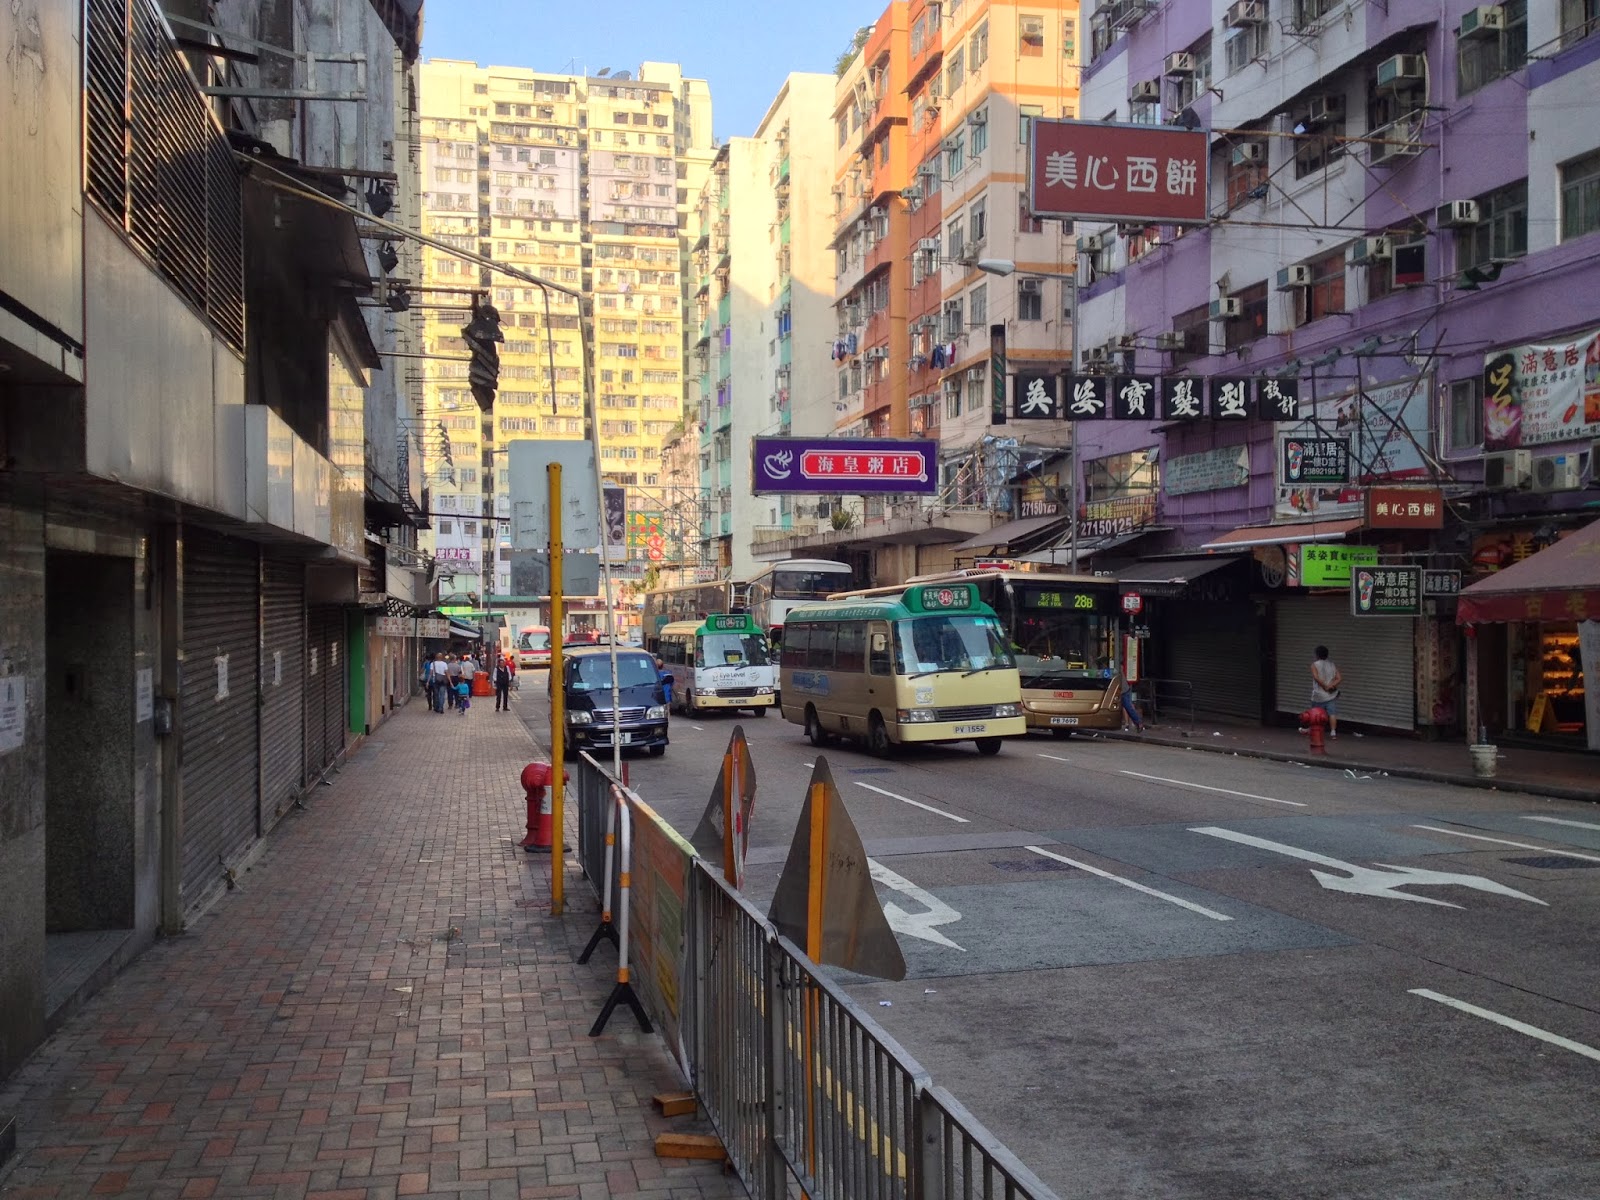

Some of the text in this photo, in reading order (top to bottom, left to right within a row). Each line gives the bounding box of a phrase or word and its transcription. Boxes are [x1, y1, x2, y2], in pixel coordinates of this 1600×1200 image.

[1045, 151, 1197, 196] 美心西餅
[1521, 343, 1580, 374] 滿意居
[1303, 442, 1337, 457] 滿意居
[818, 455, 909, 474] 海皇粥店
[1303, 467, 1337, 475] 23892196
[1376, 503, 1435, 516] 美心西餅
[1080, 517, 1133, 537] 27150125
[1374, 571, 1408, 587] 滿意居
[1074, 594, 1093, 608] 28B
[1374, 598, 1409, 606] 23892196
[954, 724, 985, 733] PV 1552
